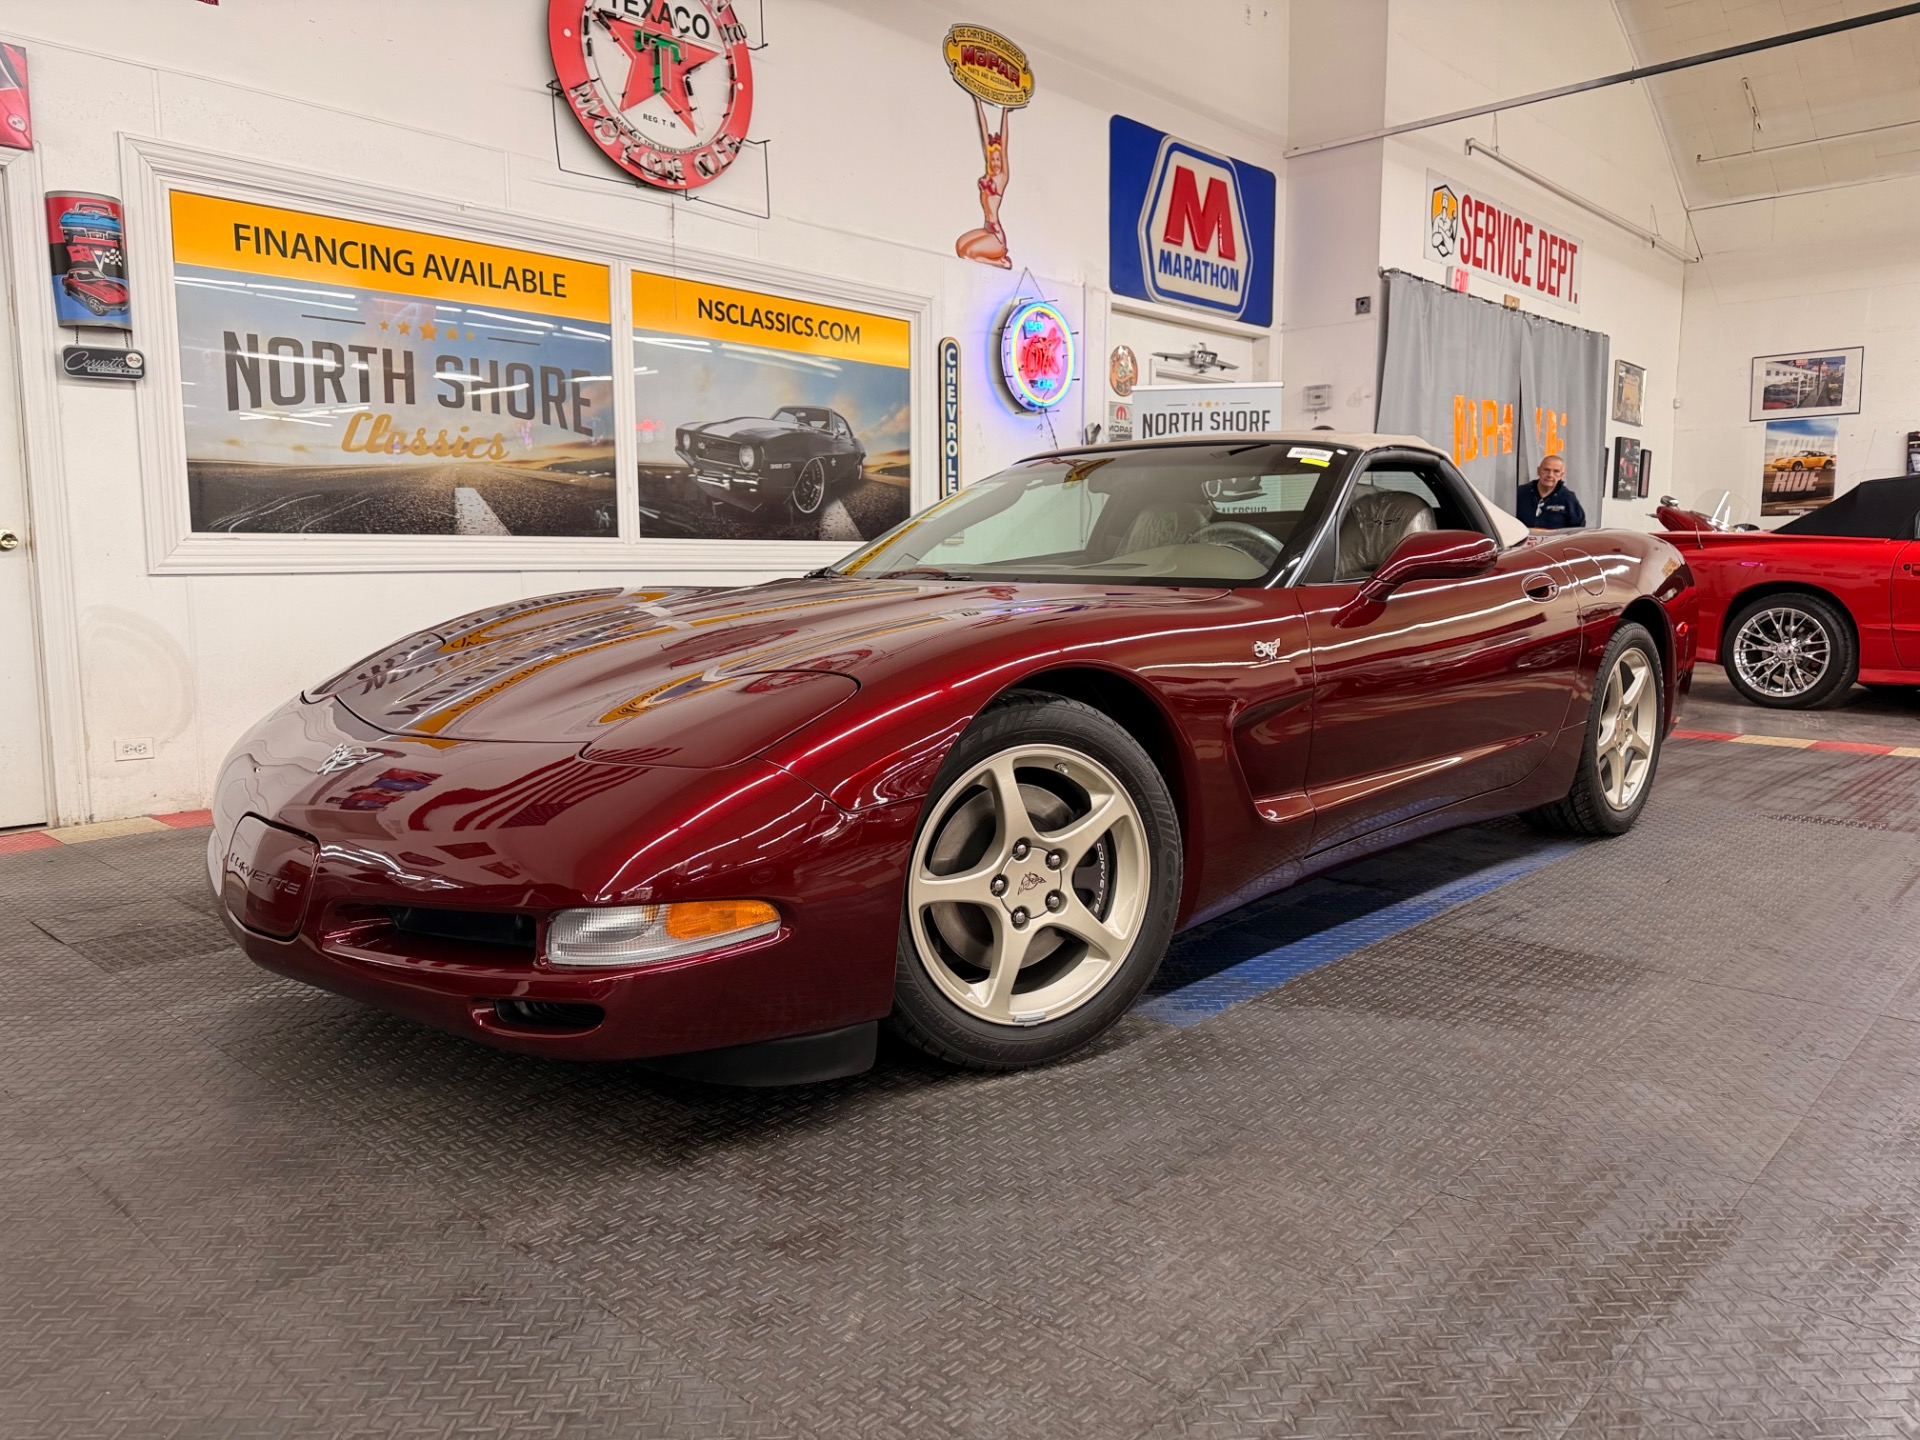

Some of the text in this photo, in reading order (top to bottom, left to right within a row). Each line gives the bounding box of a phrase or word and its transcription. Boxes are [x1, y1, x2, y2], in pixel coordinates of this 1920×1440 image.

[1163, 165, 1236, 262] M
[1459, 194, 1578, 304] SERVICE DEPT.
[233, 223, 568, 298] FINANCING AVAILABLE
[1158, 249, 1239, 292] MARATHON
[698, 298, 860, 345] NSCLASSICS.COM
[223, 330, 594, 437] NORTH SHORE
[341, 412, 510, 461] Classics
[946, 347, 958, 496] CHEVROLE
[1142, 412, 1203, 439] NORTH
[1771, 471, 1819, 493] RIDE
[1094, 843, 1106, 914] CORVETTE
